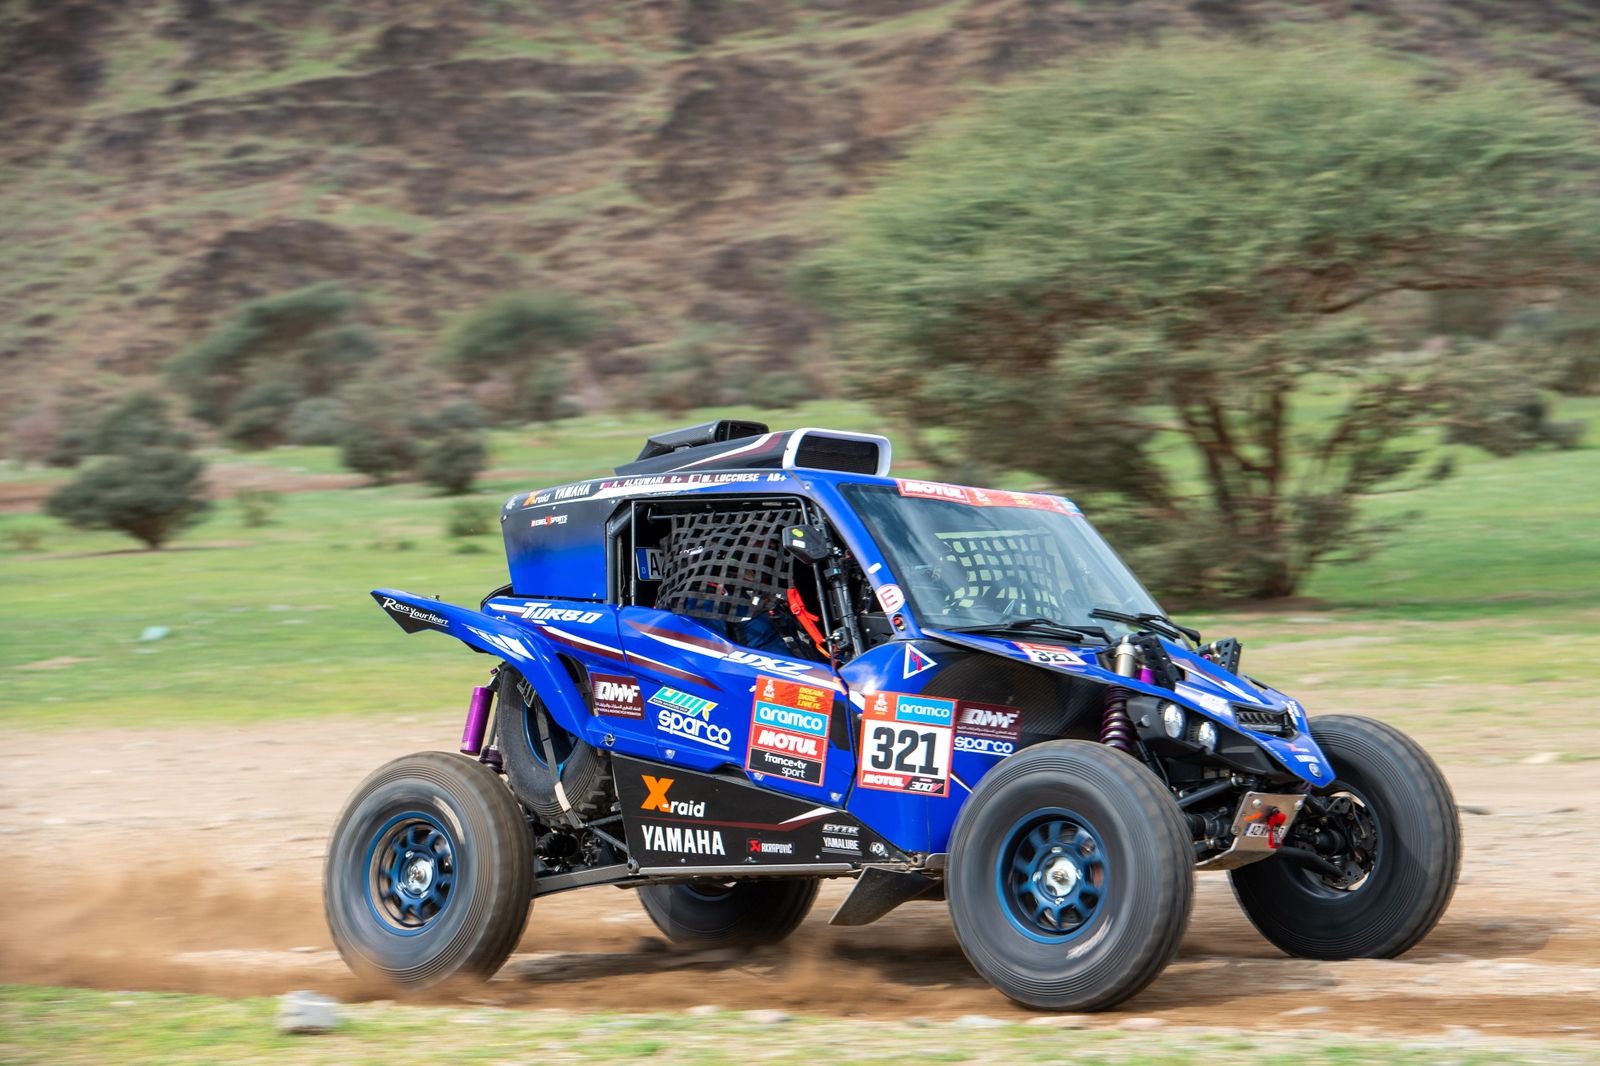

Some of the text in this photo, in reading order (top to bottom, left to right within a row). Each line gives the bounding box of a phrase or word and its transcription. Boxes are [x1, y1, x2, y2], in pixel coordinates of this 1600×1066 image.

[714, 473, 760, 483] LUCCHESE
[767, 473, 787, 483] AB+
[555, 483, 591, 500] YAMAHA
[905, 482, 965, 499] MOTUL
[428, 613, 449, 626] Heart
[1032, 650, 1079, 662] 321
[760, 707, 823, 730] aramco
[900, 703, 950, 718] aramco
[657, 709, 732, 746] sparco
[757, 729, 818, 756] MOTUL
[871, 726, 939, 776] 321
[954, 736, 1013, 753] sparco
[782, 766, 805, 779] sport
[863, 773, 904, 787] MOTUL
[641, 824, 726, 856] YAMAHA
[823, 836, 860, 851] YAMALUBE
